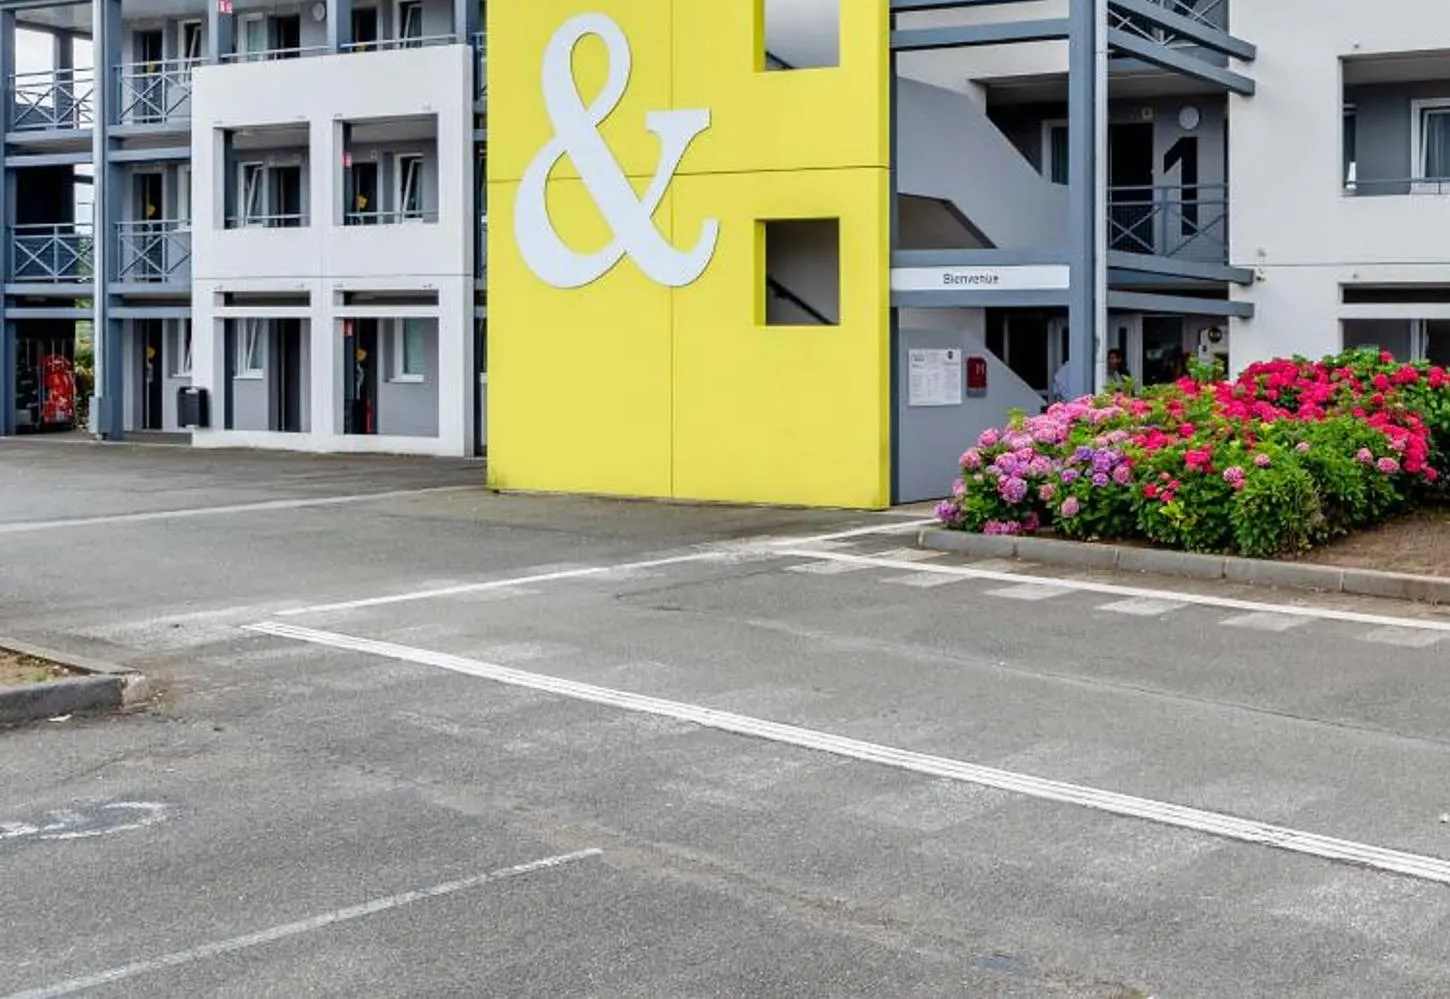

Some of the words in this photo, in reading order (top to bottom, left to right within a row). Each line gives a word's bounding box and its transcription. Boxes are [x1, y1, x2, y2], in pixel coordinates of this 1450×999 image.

[513, 11, 720, 290] &
[1163, 136, 1198, 236] 1
[942, 273, 999, 285] Bienvenue
